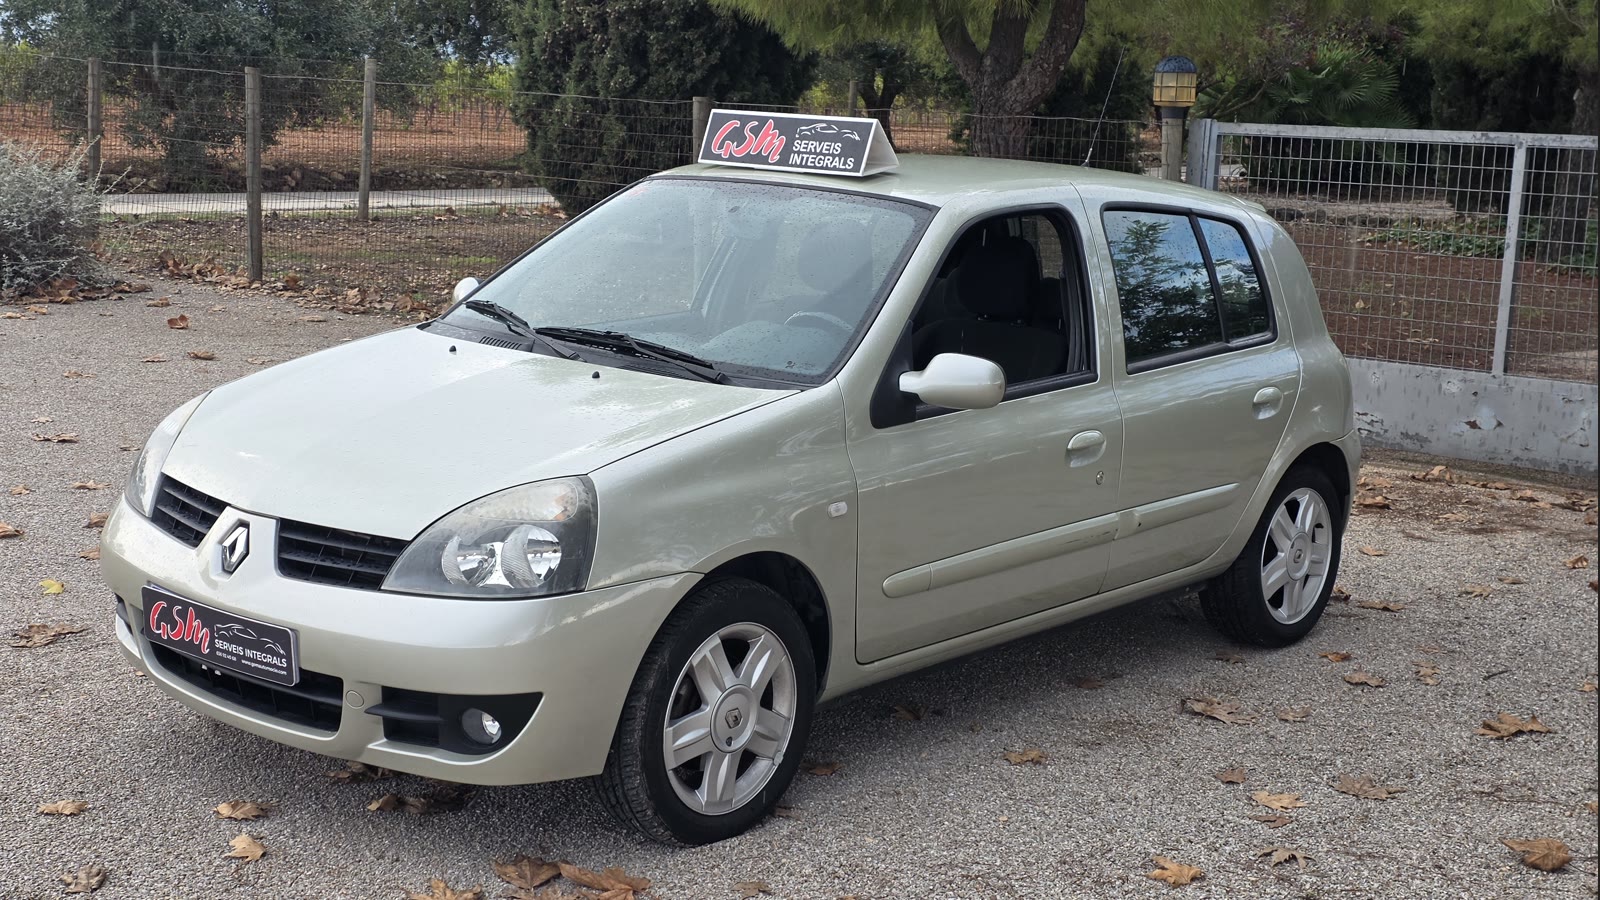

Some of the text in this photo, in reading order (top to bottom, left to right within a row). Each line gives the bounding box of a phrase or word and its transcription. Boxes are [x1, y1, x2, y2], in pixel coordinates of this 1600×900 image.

[793, 139, 842, 155] SERVEIS
[789, 152, 855, 170] INTEGRALS
[214, 639, 287, 668] SERVEIS INTEGRALS
